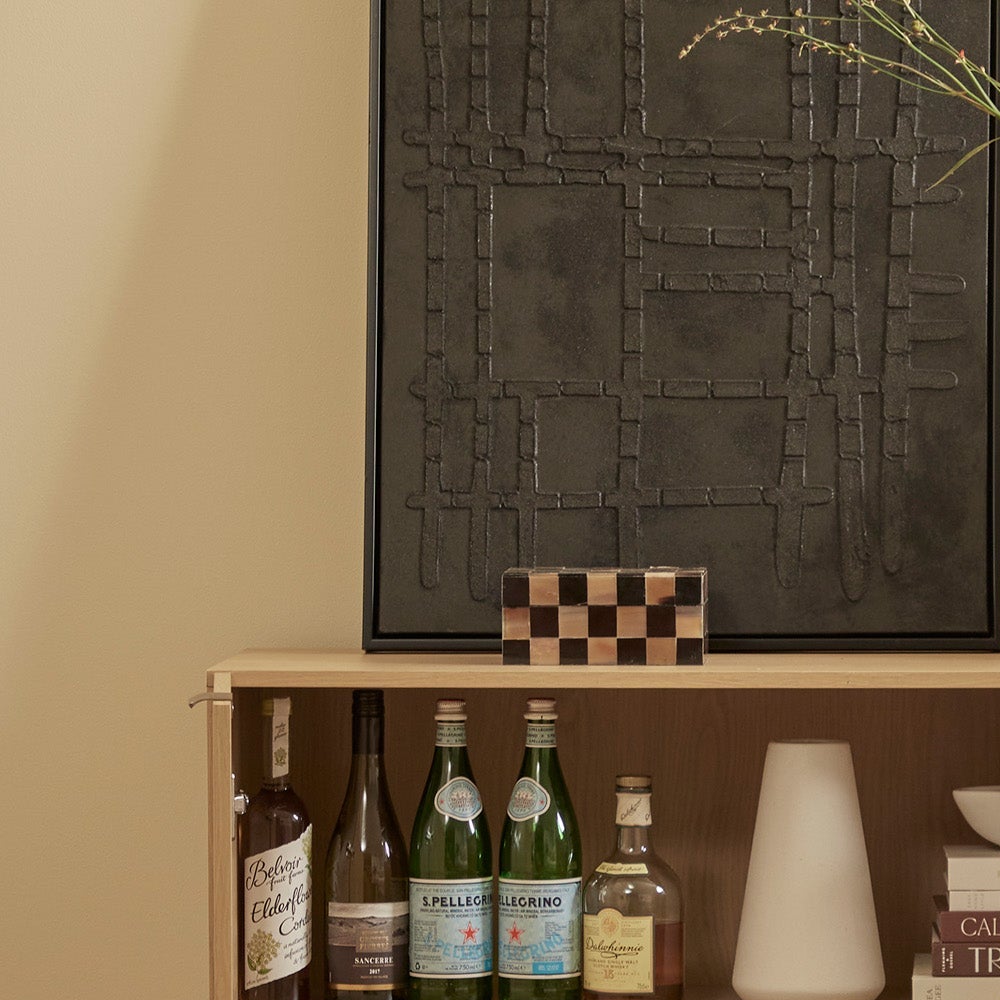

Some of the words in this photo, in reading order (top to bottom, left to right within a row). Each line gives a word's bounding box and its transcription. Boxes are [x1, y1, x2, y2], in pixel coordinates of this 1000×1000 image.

[246, 855, 302, 891] Belvoir
[586, 937, 644, 955] Dalwhinnie
[354, 956, 394, 965] SANCERRE
